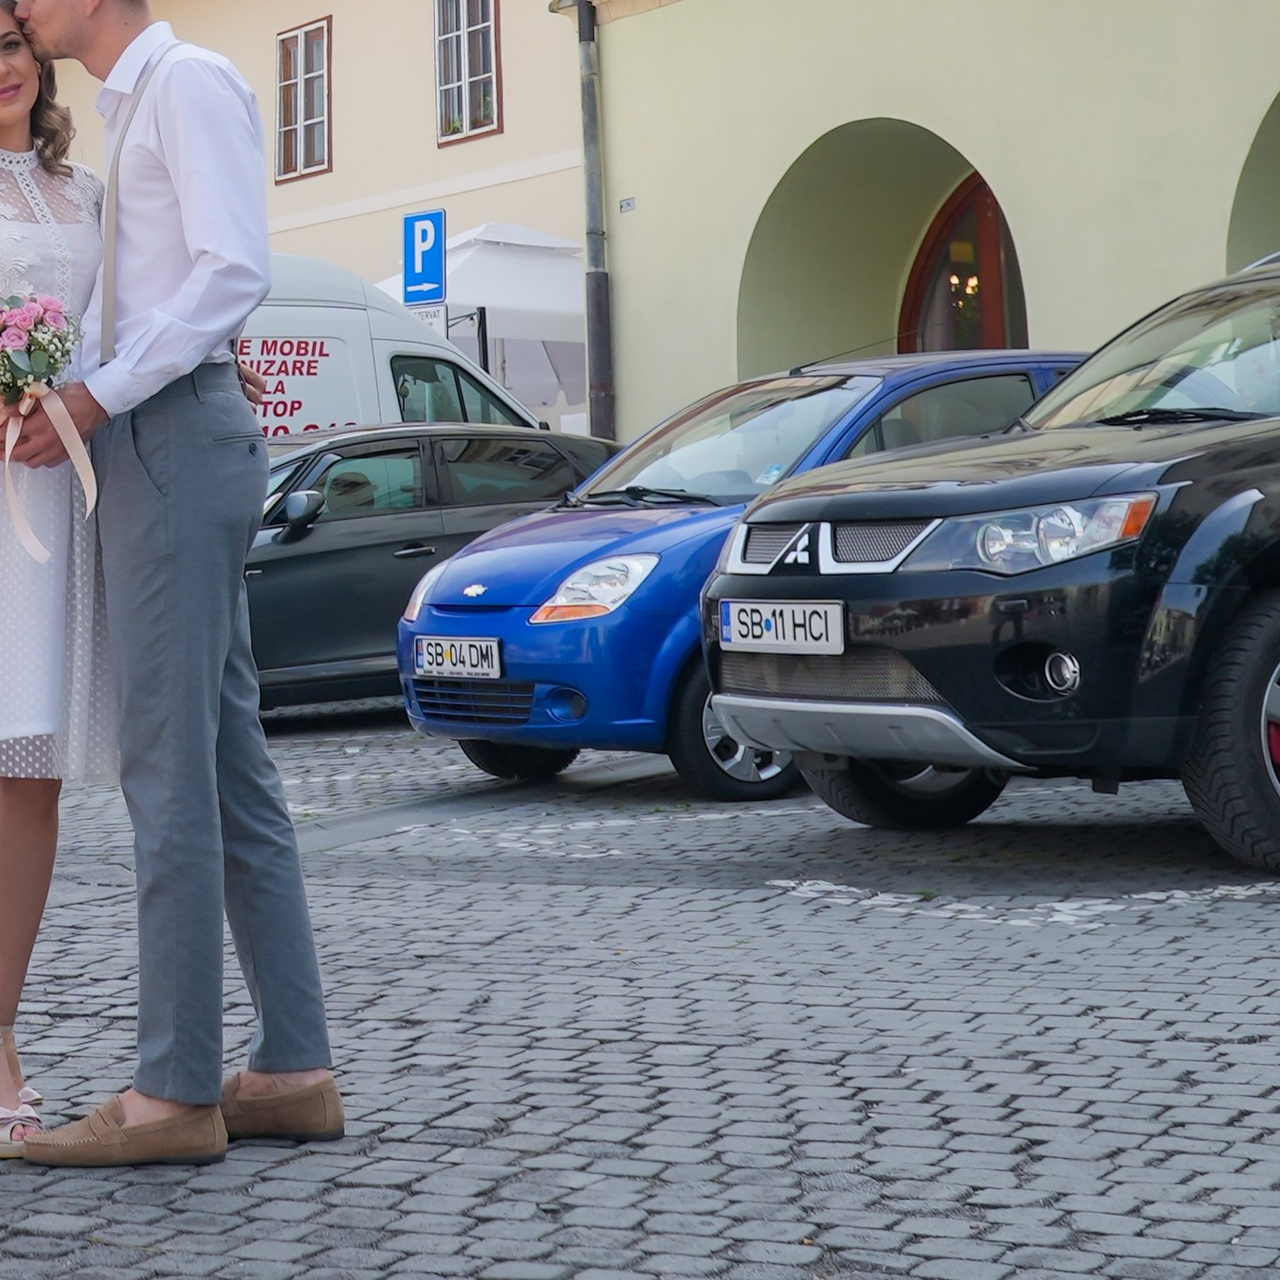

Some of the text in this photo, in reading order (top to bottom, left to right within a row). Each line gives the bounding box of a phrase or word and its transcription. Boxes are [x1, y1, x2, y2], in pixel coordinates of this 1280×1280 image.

[414, 219, 436, 274] P
[260, 339, 330, 357] MOBIL
[737, 608, 764, 639] SB
[771, 608, 786, 640] 11
[791, 610, 829, 642] HCI
[426, 642, 445, 667] SB
[449, 643, 466, 668] 04
